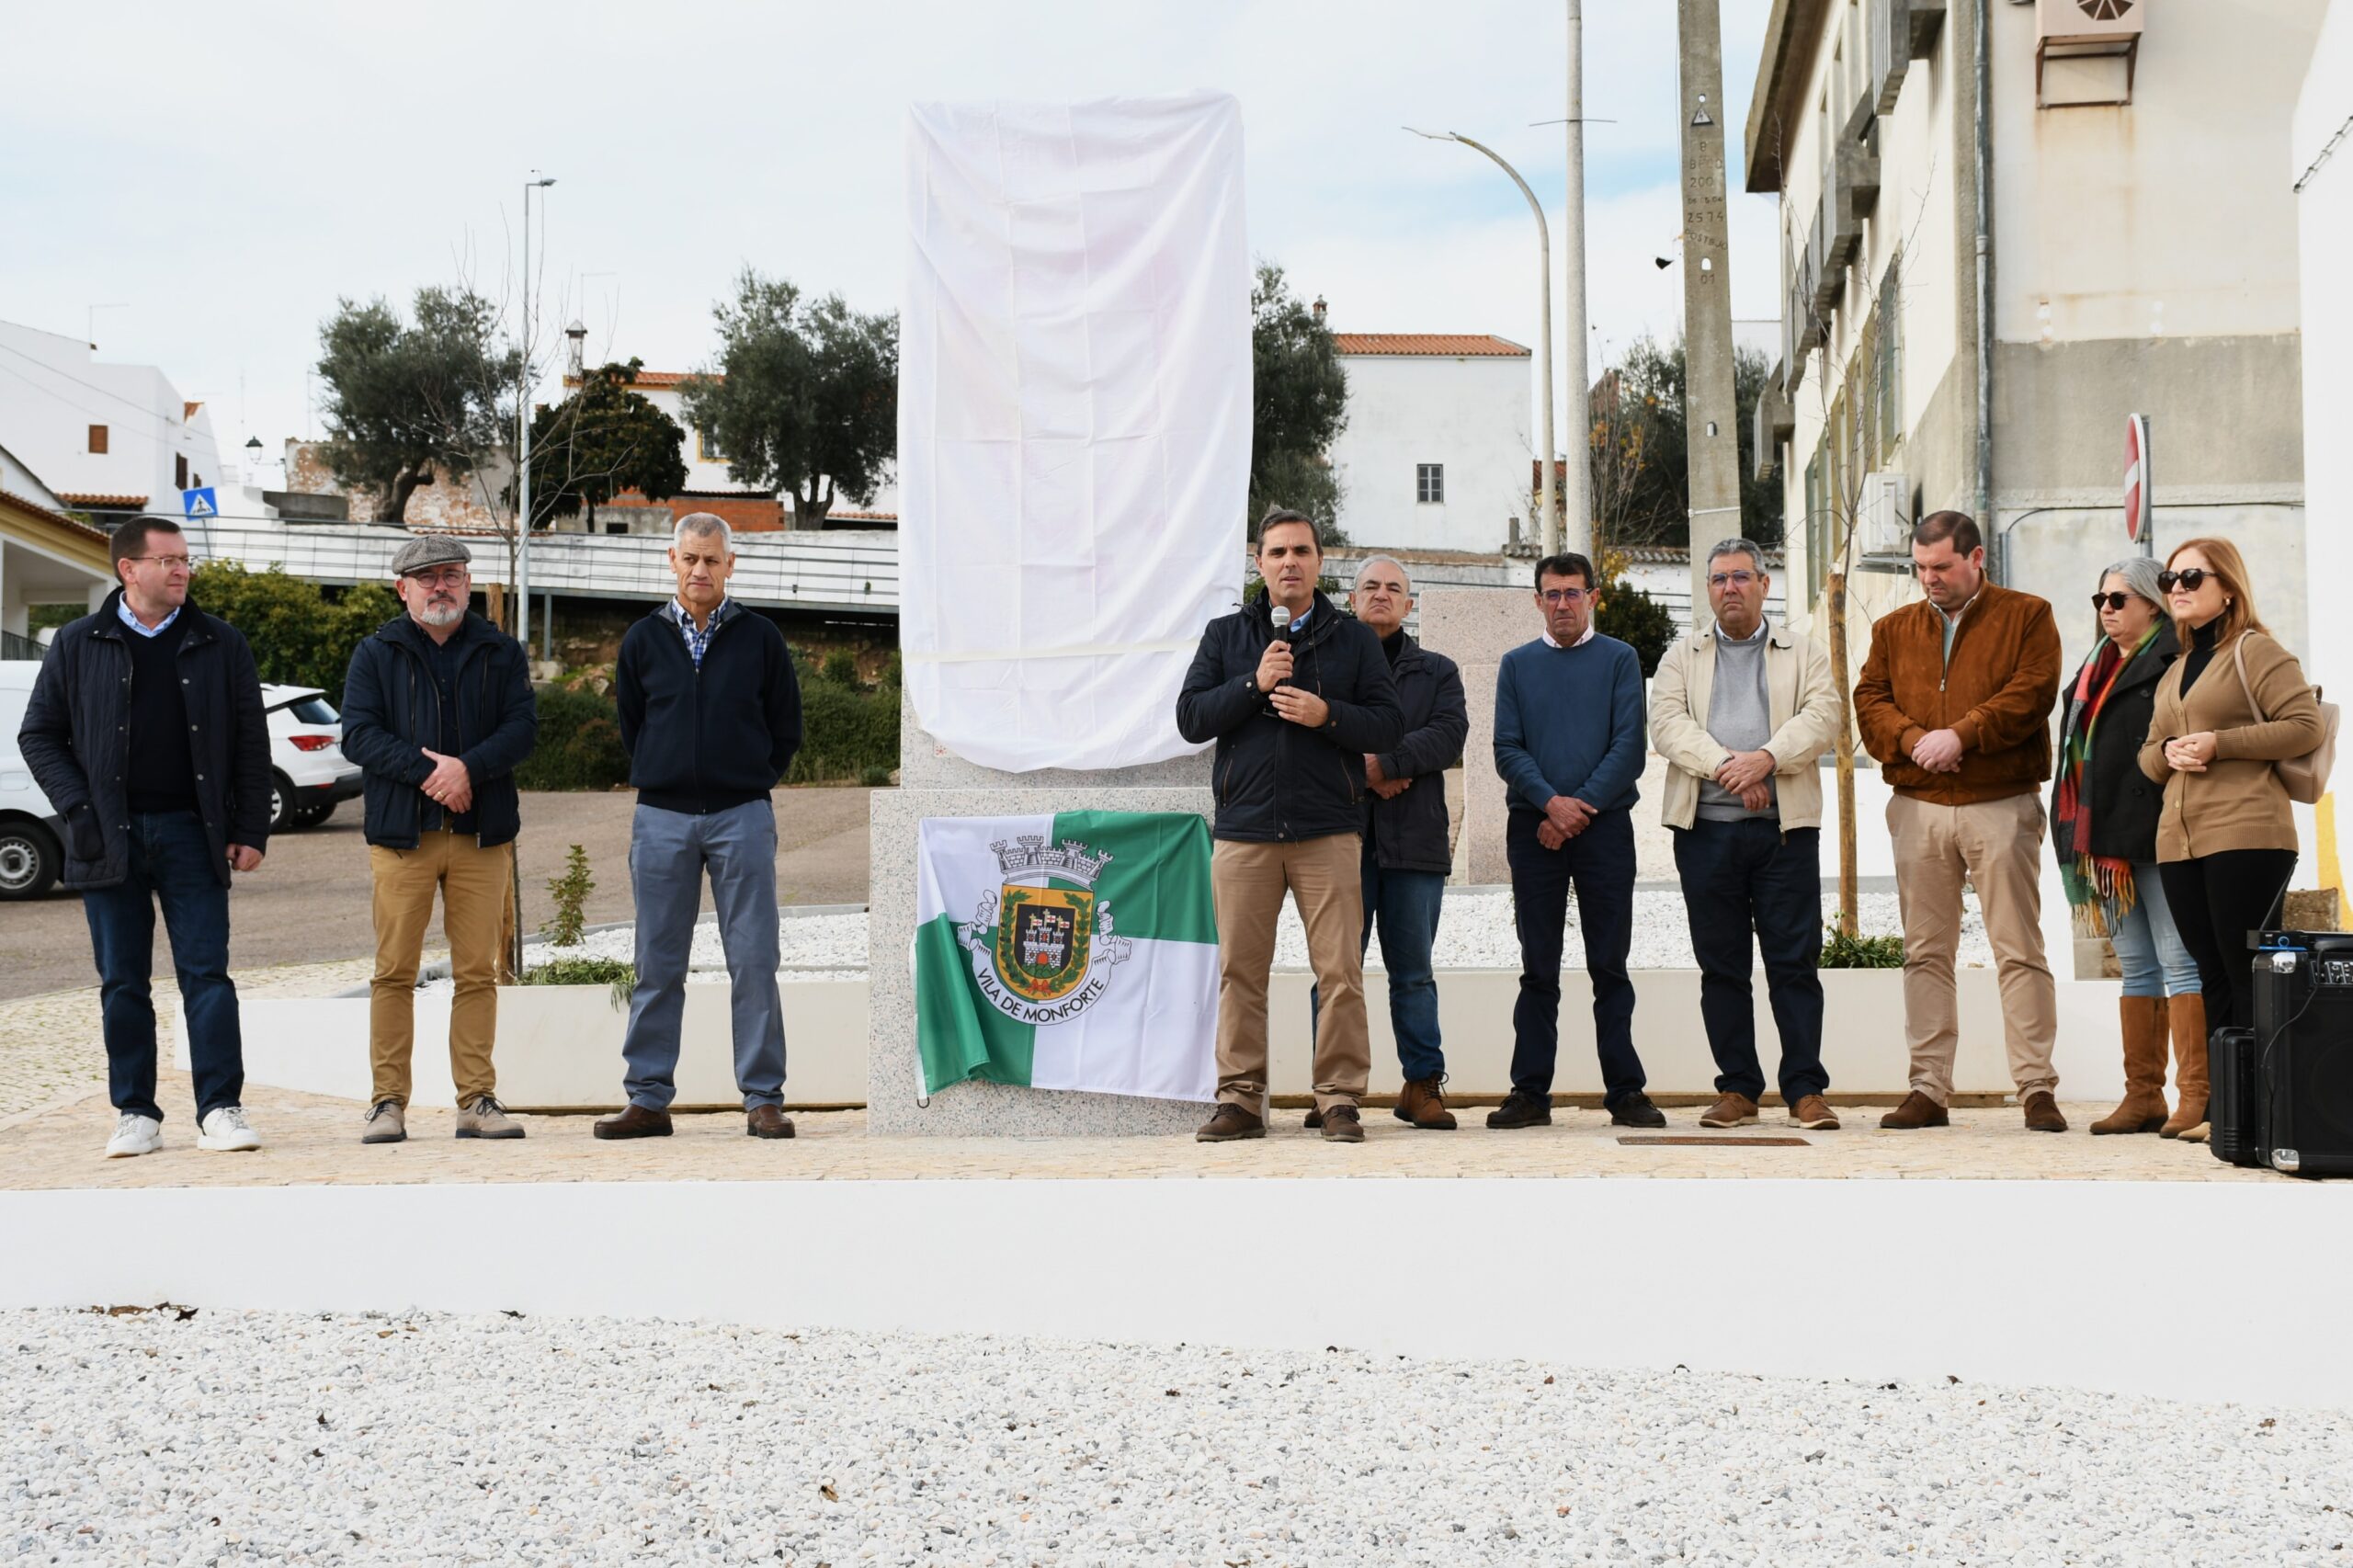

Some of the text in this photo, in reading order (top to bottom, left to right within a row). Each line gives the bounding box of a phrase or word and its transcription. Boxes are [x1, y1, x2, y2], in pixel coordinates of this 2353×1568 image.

[977, 967, 1105, 1022] VILA DE MONFORTE
